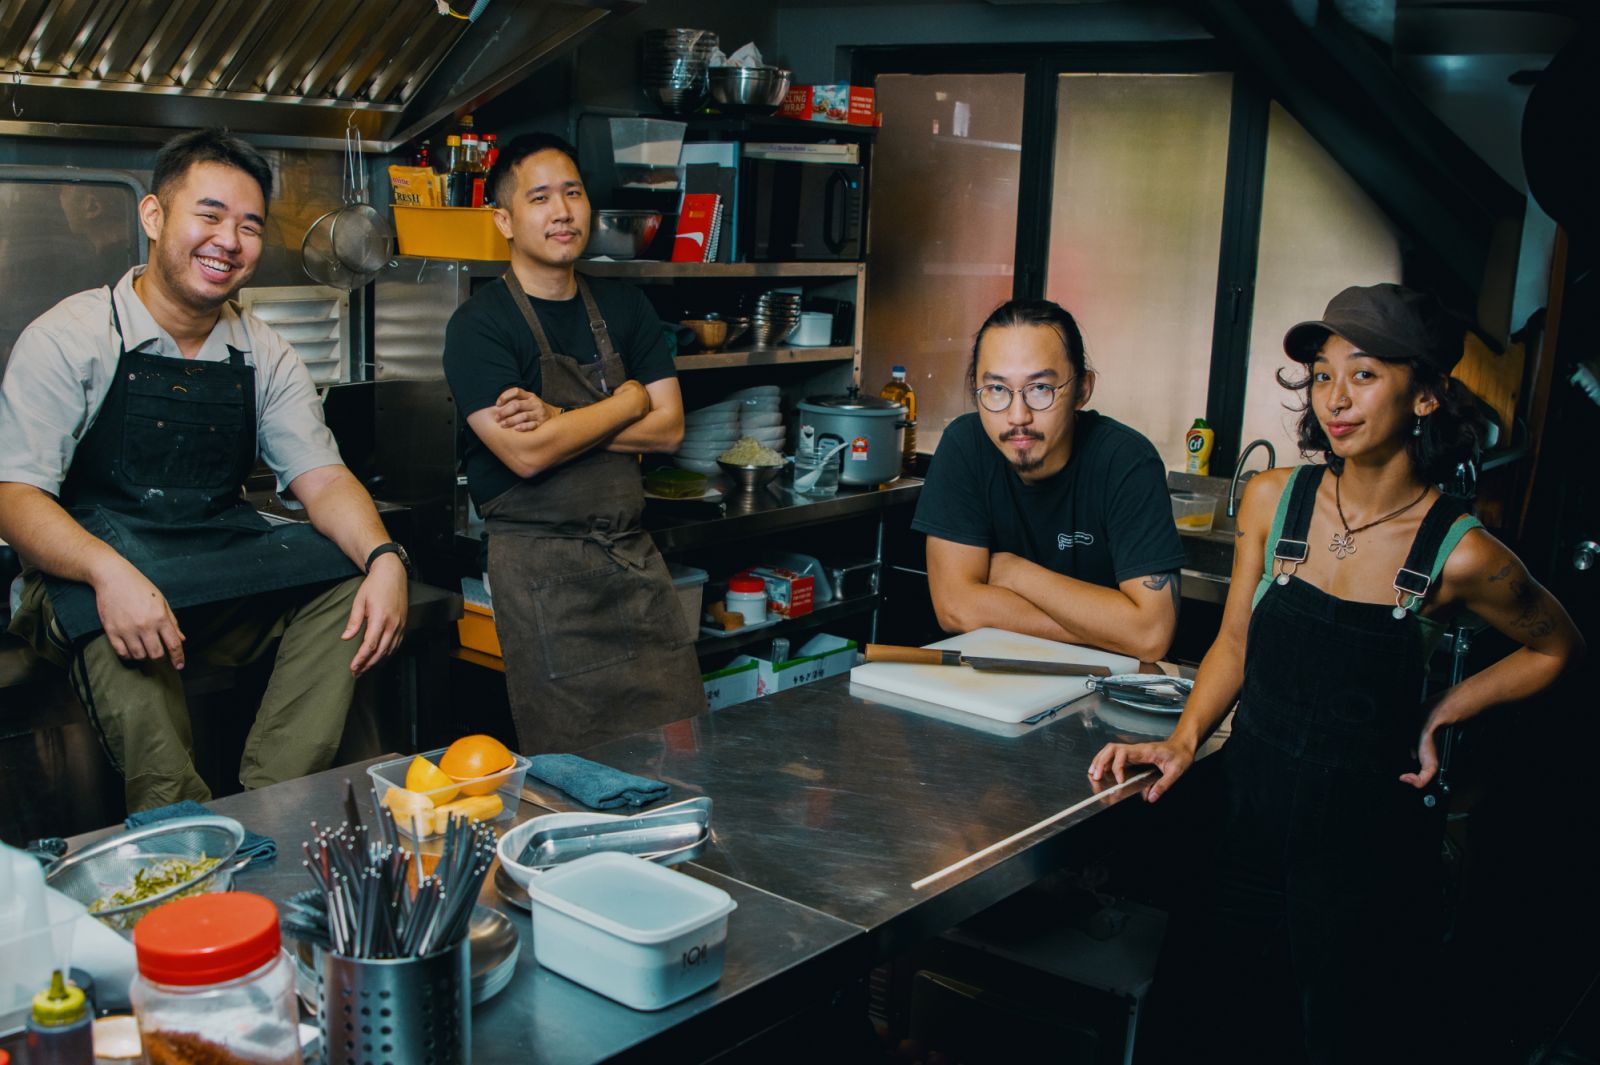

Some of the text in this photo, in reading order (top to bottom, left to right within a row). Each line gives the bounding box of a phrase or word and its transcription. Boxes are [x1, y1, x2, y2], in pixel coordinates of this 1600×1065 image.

[783, 94, 807, 103] CLING
[783, 103, 806, 112] WRAP
[1189, 436, 1203, 451] Cif
